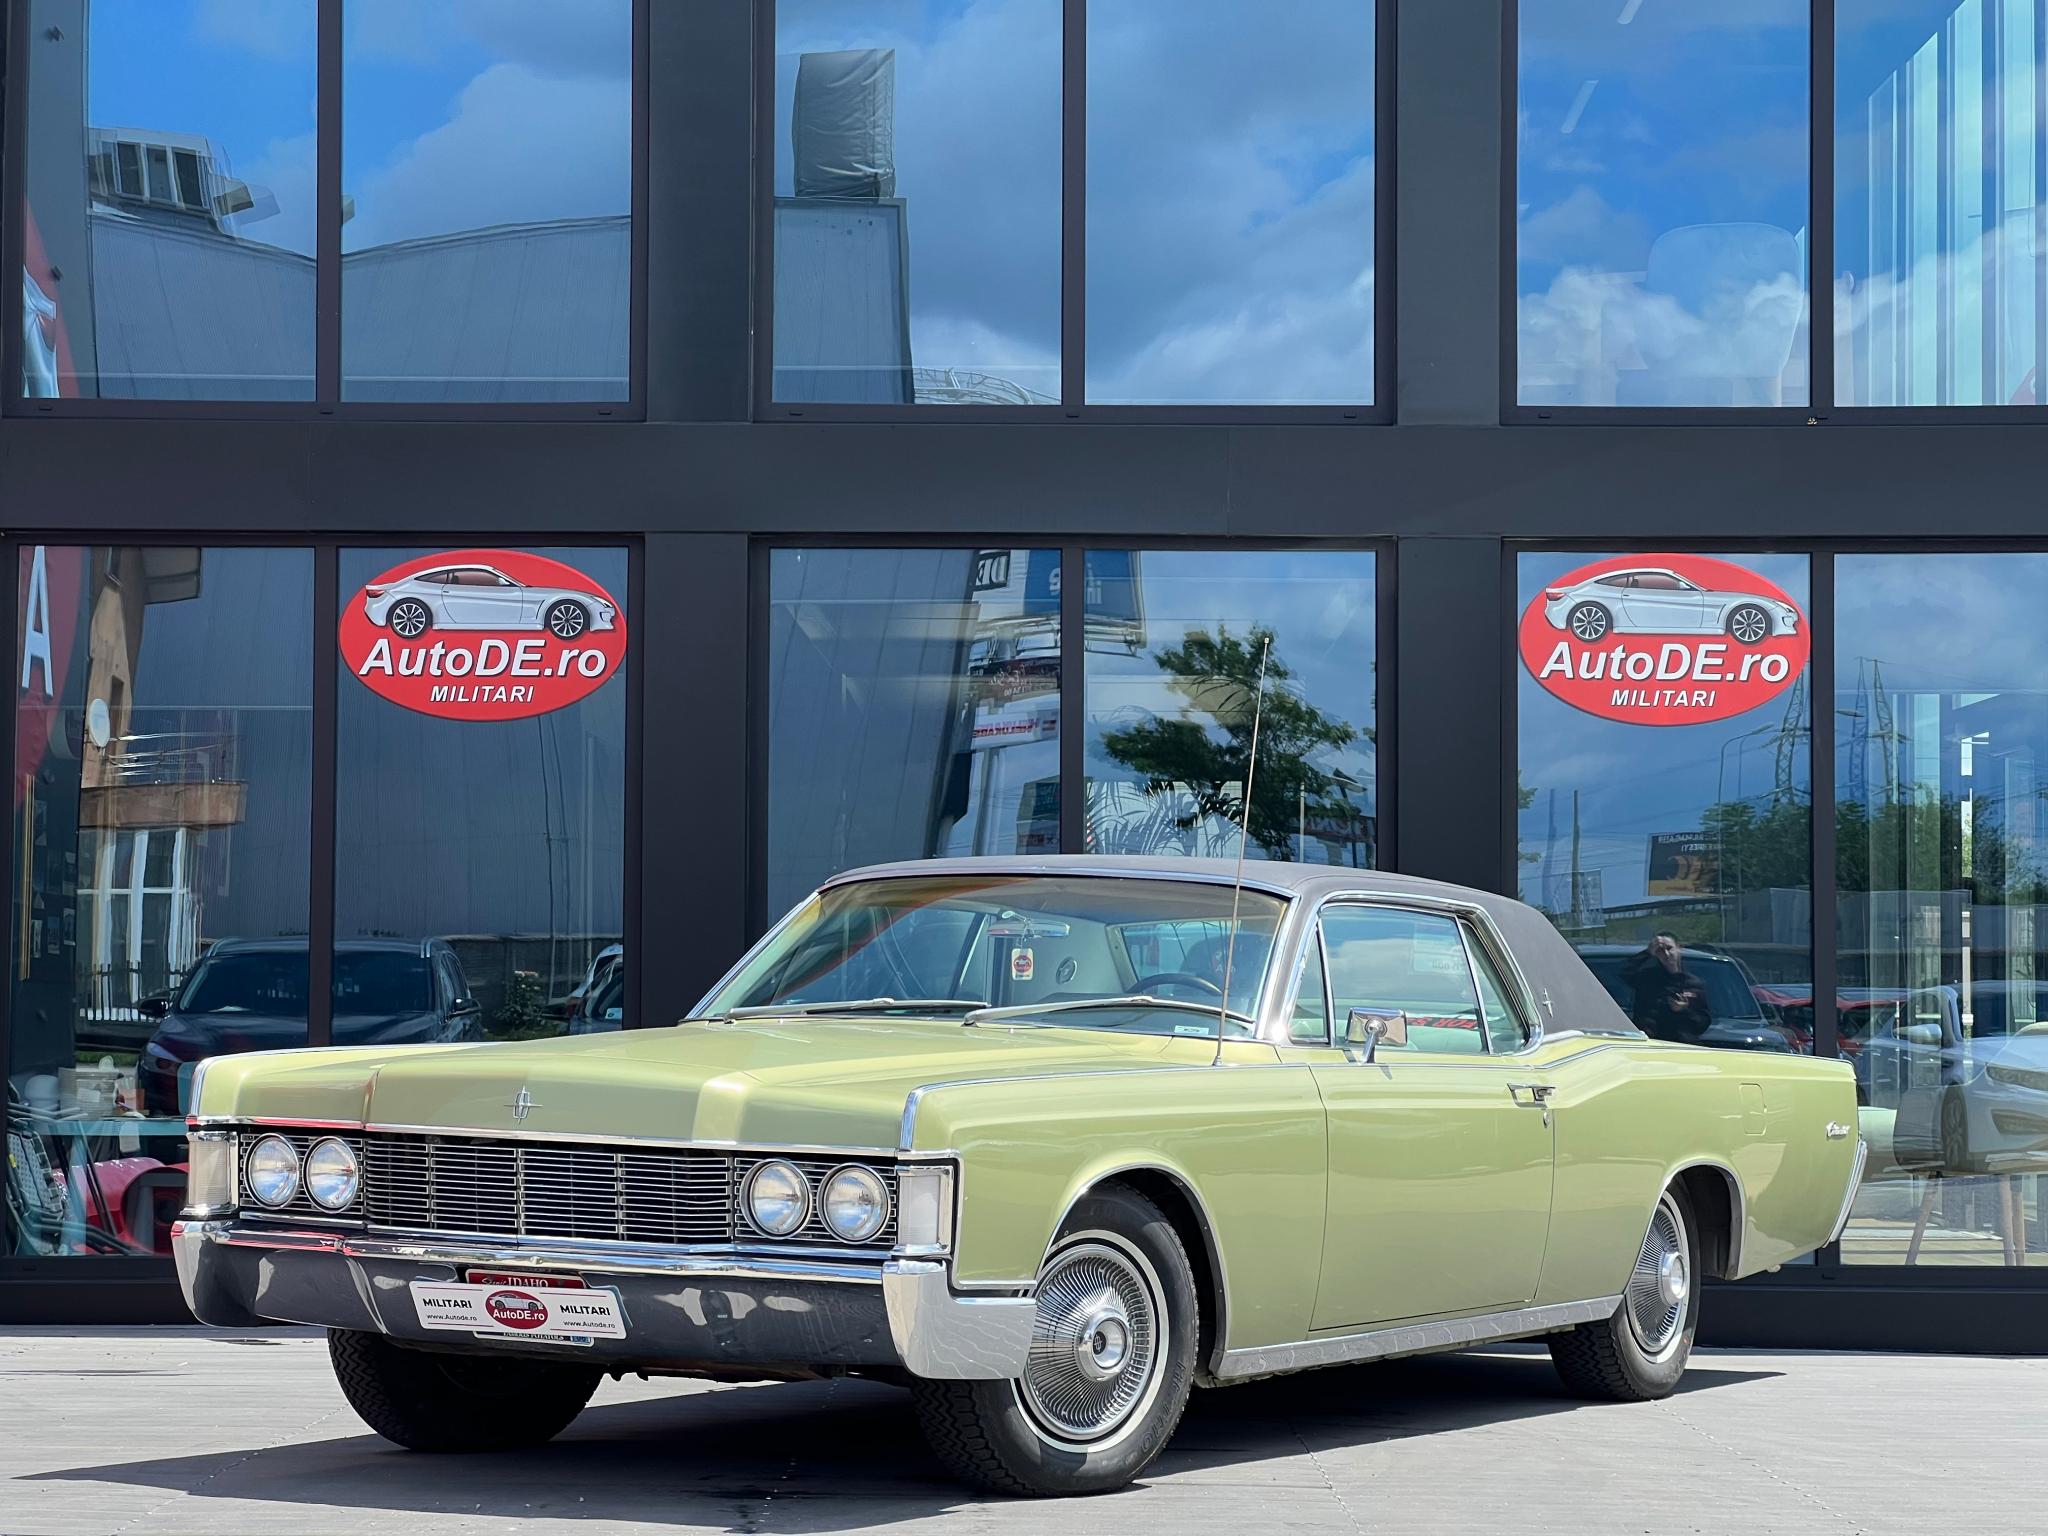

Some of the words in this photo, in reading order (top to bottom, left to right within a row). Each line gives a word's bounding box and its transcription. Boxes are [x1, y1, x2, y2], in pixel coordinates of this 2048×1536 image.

[358, 638, 606, 678] AutoDE.ro
[1539, 641, 1790, 683] AutoDE.ro
[430, 685, 534, 702] MILITARI
[1611, 689, 1716, 707] MILITARI
[422, 1298, 473, 1309] MILITARI
[493, 1309, 545, 1321] AutoDE.ro
[559, 1304, 611, 1316] MILITARI
[426, 1313, 478, 1322] www.Autode.ro
[563, 1320, 616, 1329] www.Autode.ro
